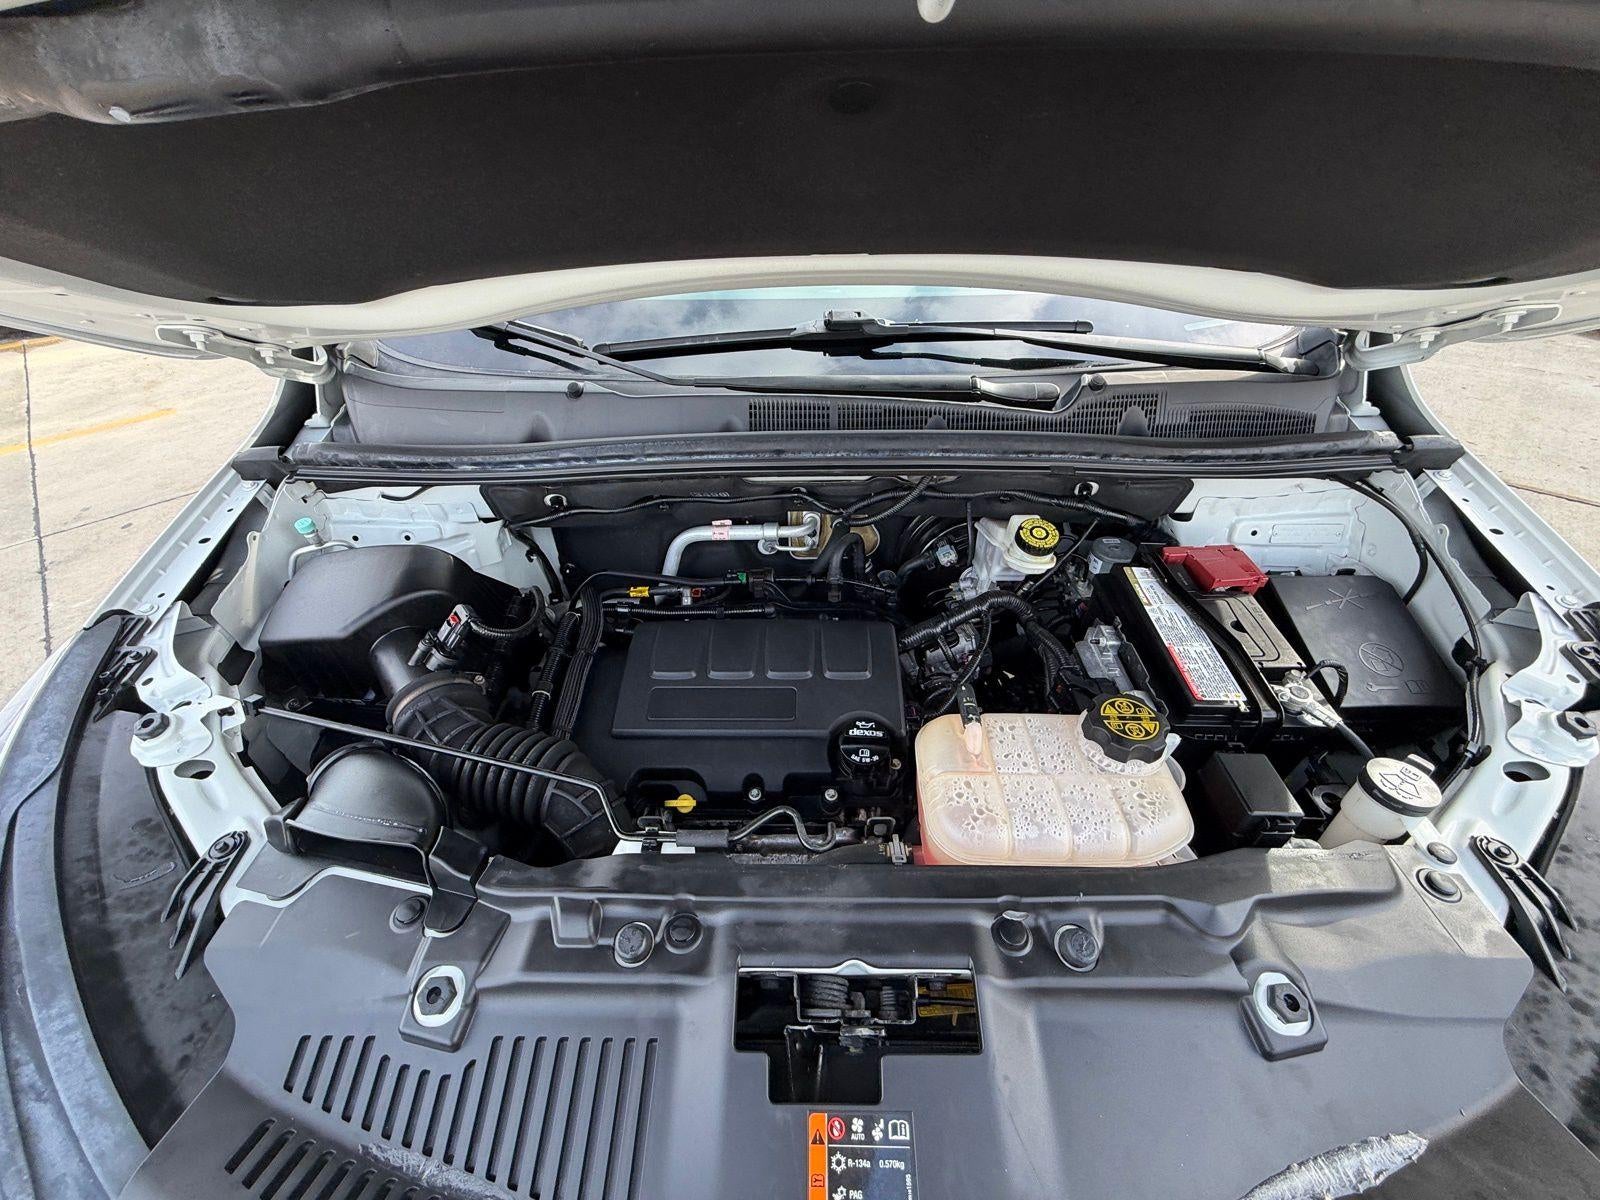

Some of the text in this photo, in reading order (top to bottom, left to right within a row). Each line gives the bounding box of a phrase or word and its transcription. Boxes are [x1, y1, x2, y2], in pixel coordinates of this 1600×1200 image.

[848, 728, 884, 737] dexos
[850, 1133, 865, 1141] AUTO
[847, 1158, 905, 1170] R-134a 0.570kg
[849, 1189, 863, 1199] PAG
